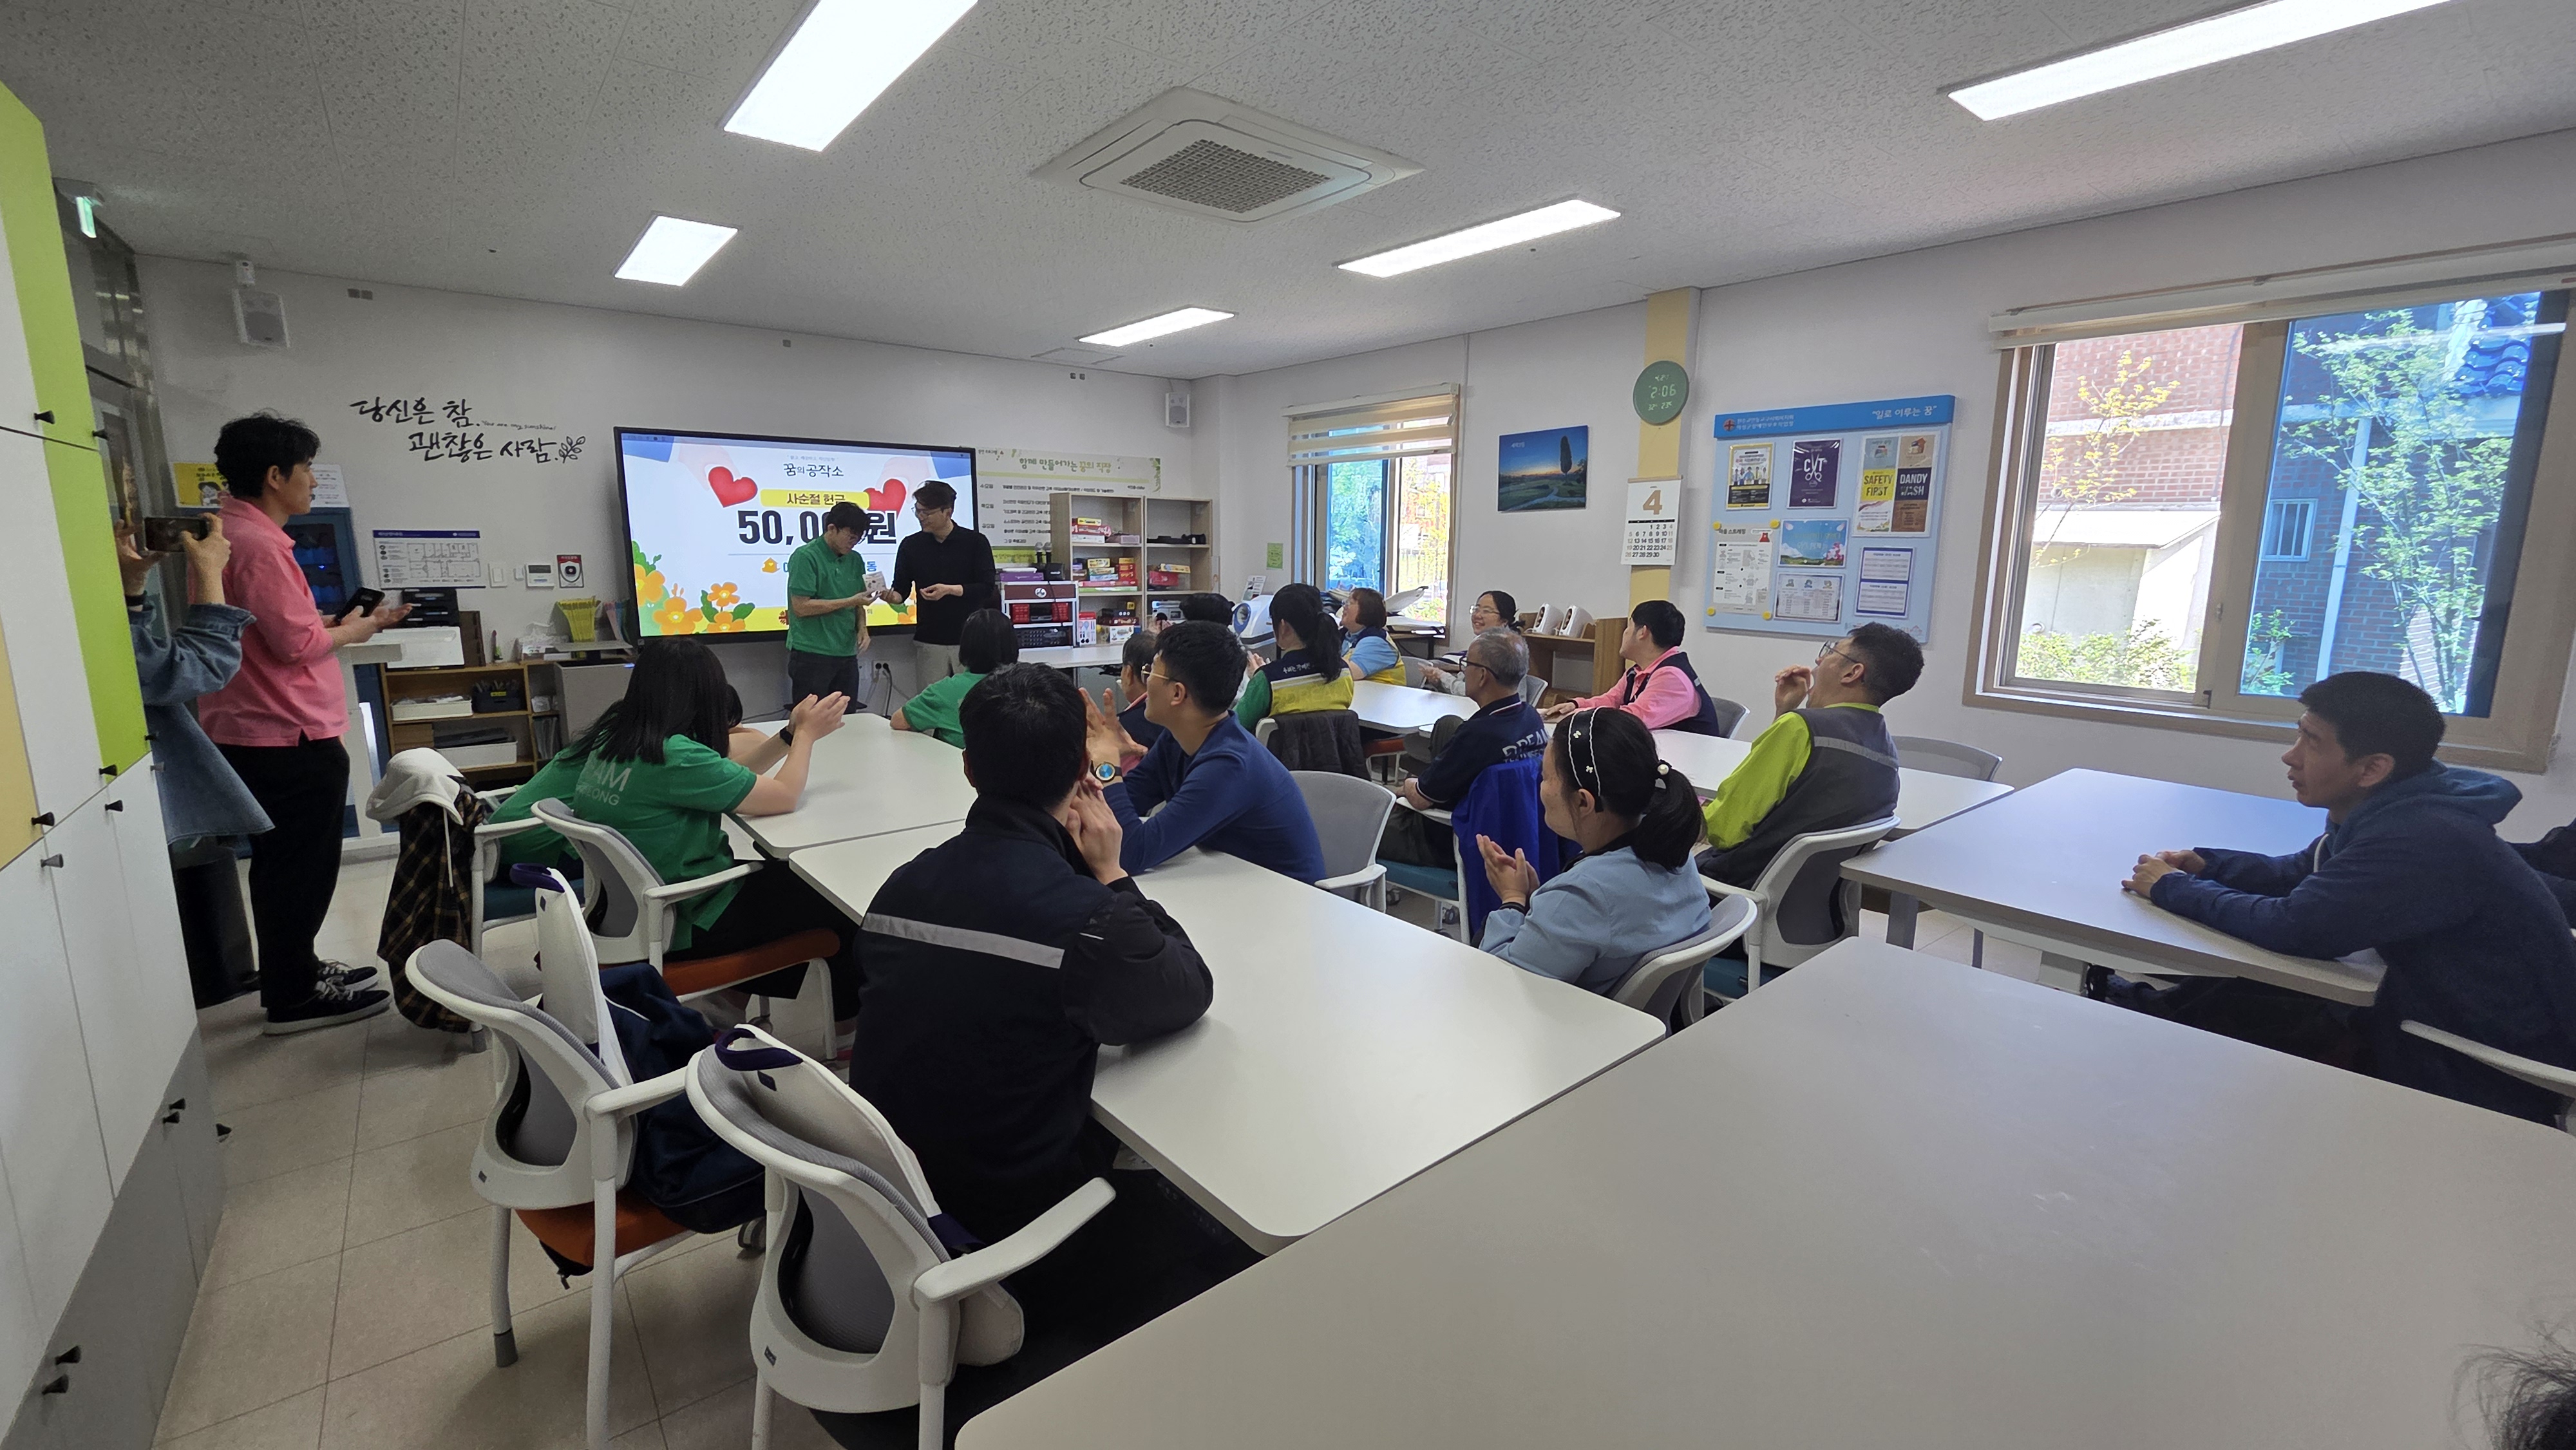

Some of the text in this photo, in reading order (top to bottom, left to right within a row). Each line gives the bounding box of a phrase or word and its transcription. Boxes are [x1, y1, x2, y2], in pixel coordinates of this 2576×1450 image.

[350, 397, 435, 424] 당신은
[409, 431, 493, 462] 괜찮은
[1019, 458, 1037, 469] 함께
[1039, 458, 1078, 472] 만들어가는
[1096, 462, 1112, 474] 직장
[1864, 475, 1893, 485] SAFETY
[1900, 473, 1928, 484] DANDY
[1866, 487, 1888, 496] FIRST
[787, 493, 820, 505] 사순절
[1642, 489, 1663, 515] 4
